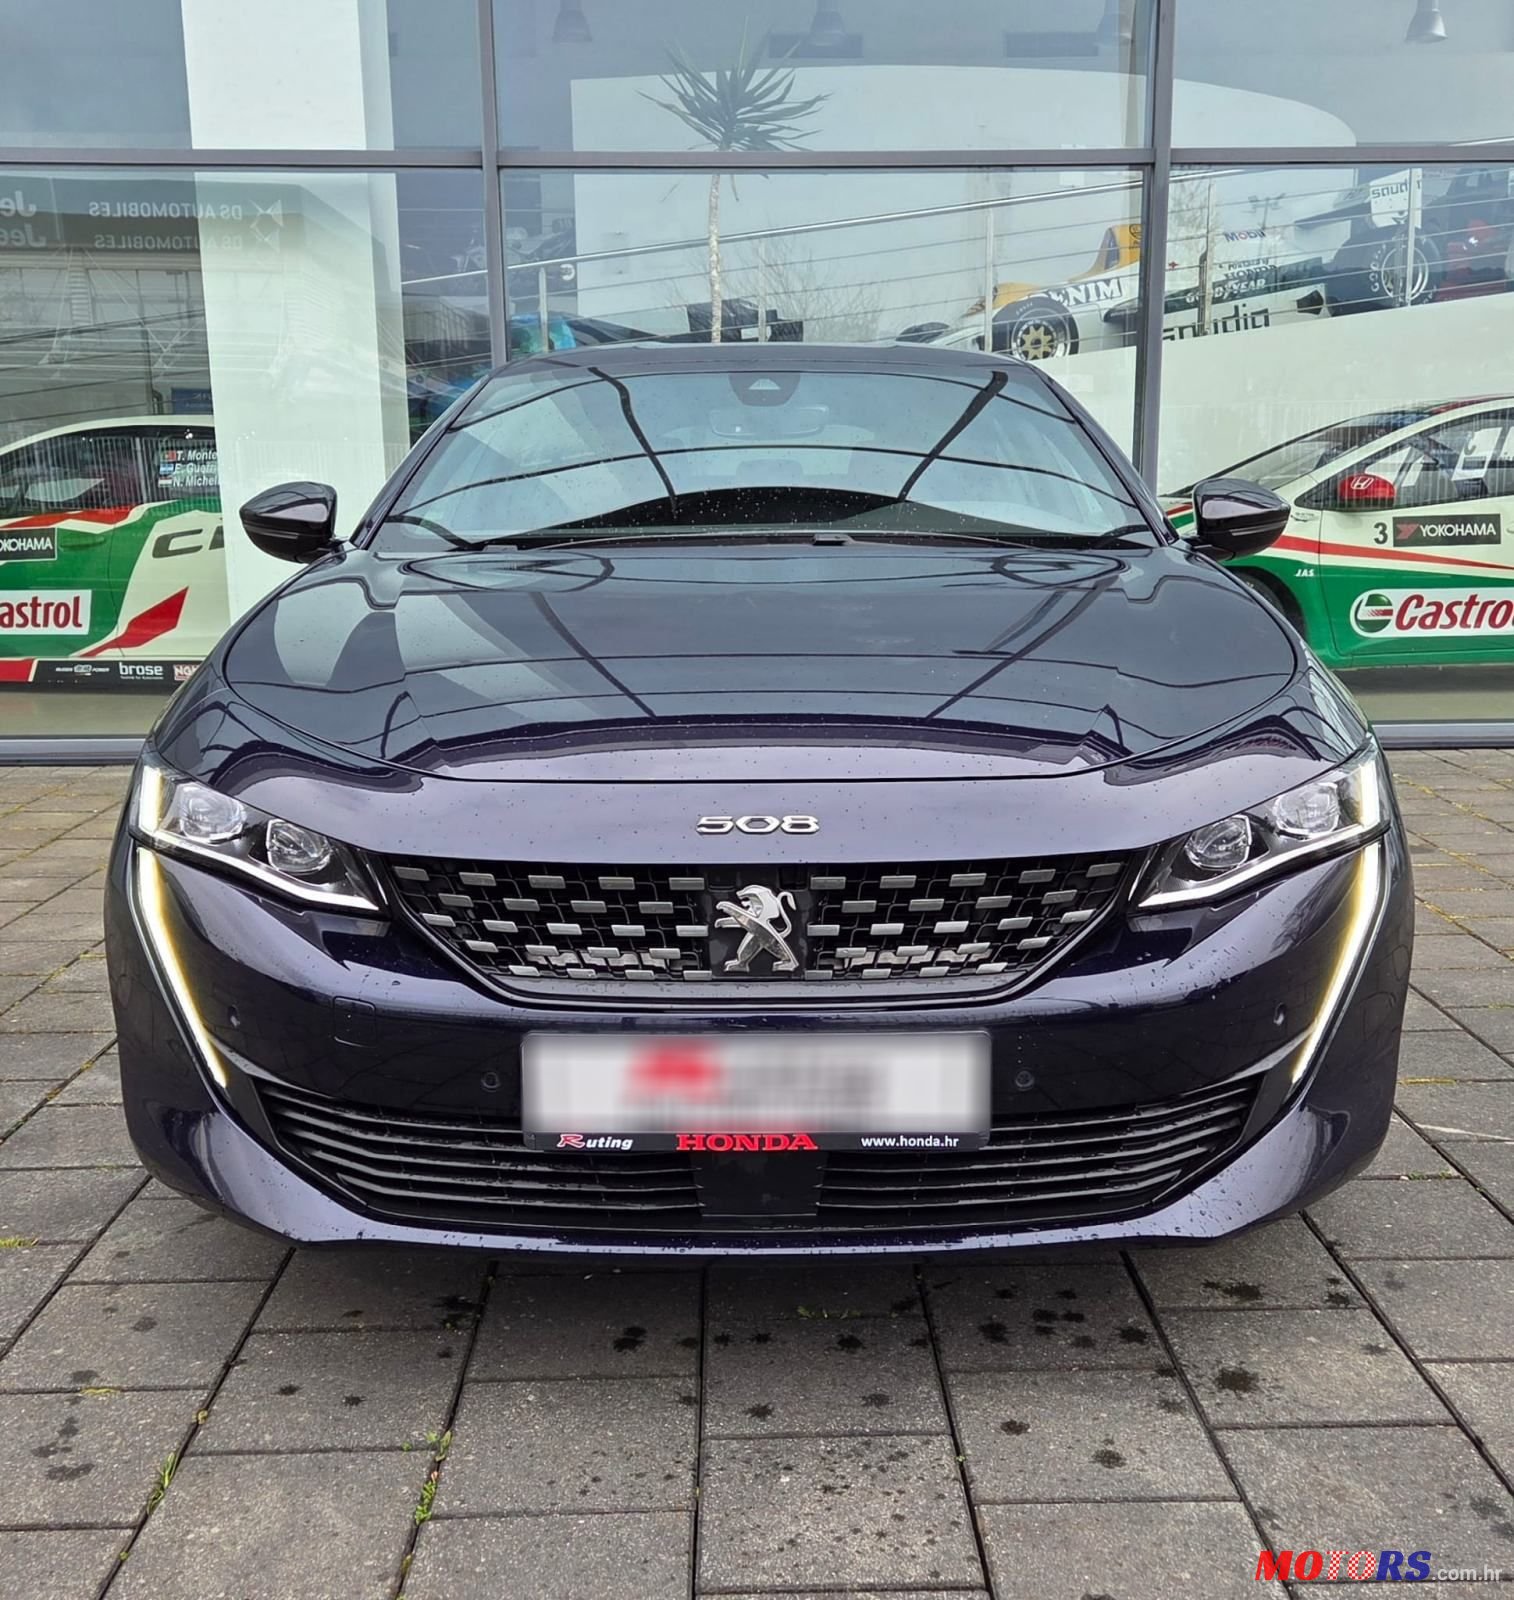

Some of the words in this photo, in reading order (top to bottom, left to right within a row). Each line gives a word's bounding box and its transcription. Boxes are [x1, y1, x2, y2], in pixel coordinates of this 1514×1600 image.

[1224, 229, 1266, 242] Mobil
[1185, 279, 1266, 303] GDYEAR
[1373, 522, 1389, 545] 3
[1420, 523, 1496, 537] YOKOHAMA
[1395, 593, 1514, 631] Castro
[118, 661, 164, 676] brose
[696, 815, 820, 835] 508
[556, 1134, 633, 1150] Ruting
[676, 1134, 818, 1151] HONDA
[861, 1135, 959, 1148] www.honda.hr
